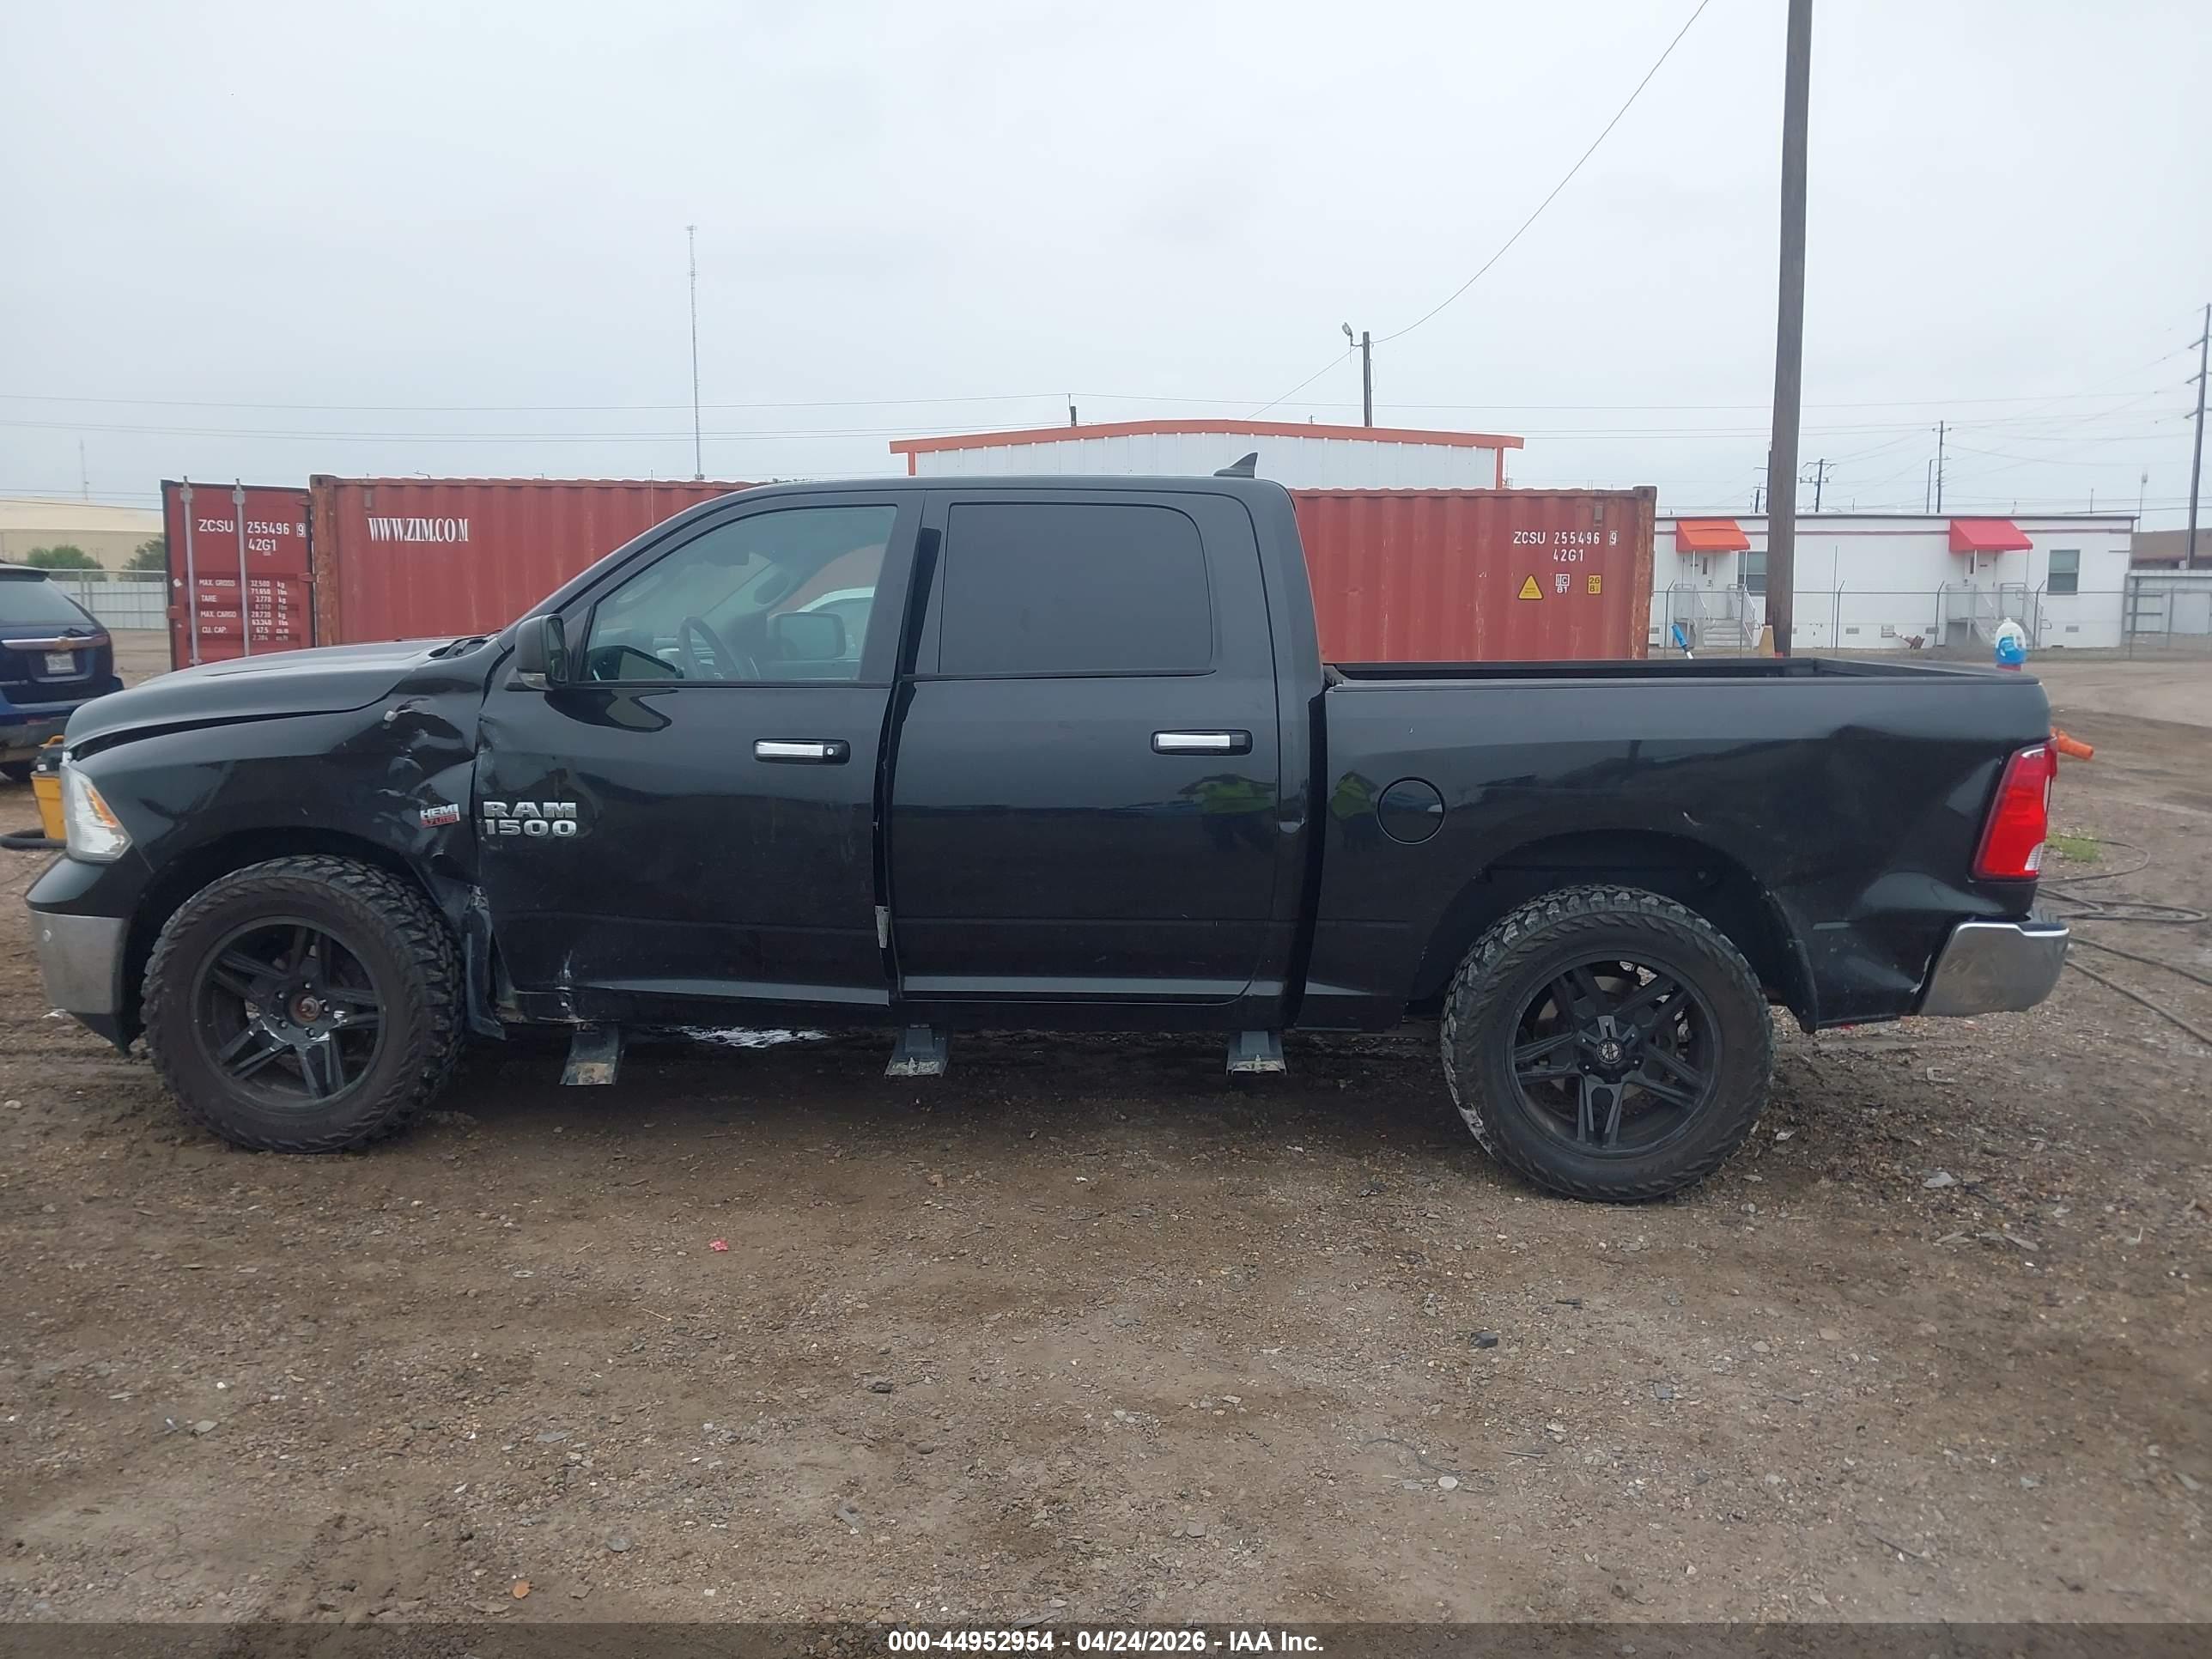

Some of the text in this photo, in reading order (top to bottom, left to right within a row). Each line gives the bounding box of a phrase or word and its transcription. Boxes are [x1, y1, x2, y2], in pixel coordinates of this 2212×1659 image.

[198, 519, 305, 536] ZCSU 255496 9
[1513, 531, 1618, 544] ZCSU 255496 9
[248, 538, 276, 551] 42G1
[1553, 549, 1583, 562] 42G1
[1557, 586, 1567, 594] 81
[420, 804, 459, 818] HEMI
[483, 801, 577, 818] RAM
[485, 819, 577, 836] 1500
